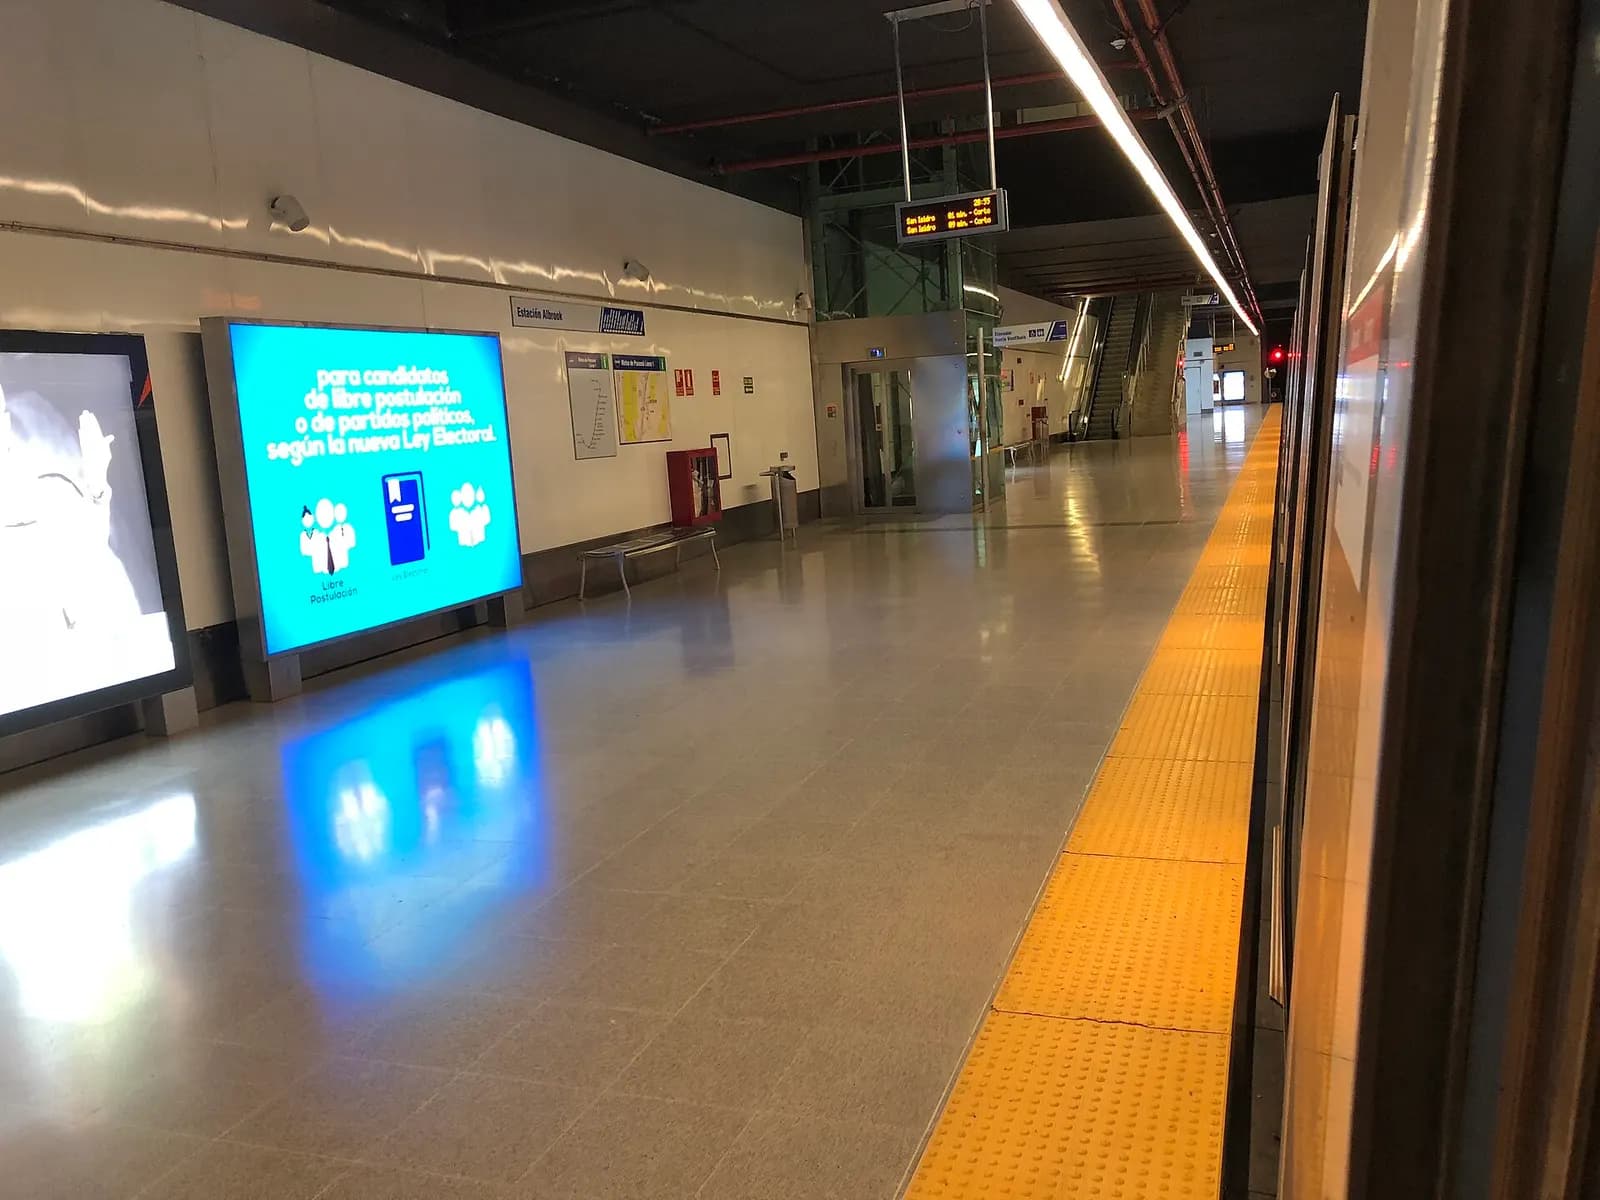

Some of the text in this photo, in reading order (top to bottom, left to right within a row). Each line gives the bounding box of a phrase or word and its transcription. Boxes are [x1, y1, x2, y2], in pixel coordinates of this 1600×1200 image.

[906, 217, 917, 225] San
[917, 215, 936, 224] Isidro
[973, 207, 991, 216] Corto
[906, 226, 918, 235] San
[918, 224, 937, 233] Isidro
[974, 216, 992, 225] Corto
[517, 306, 563, 321] Estación Albrook
[316, 365, 449, 391] para candidatos
[304, 385, 462, 413] de libre postulación
[295, 406, 475, 436] o de partidos políticos,
[266, 424, 497, 467] según la nueva Ley Electoral.
[321, 579, 345, 591] Libre
[310, 586, 359, 605] Postulación
